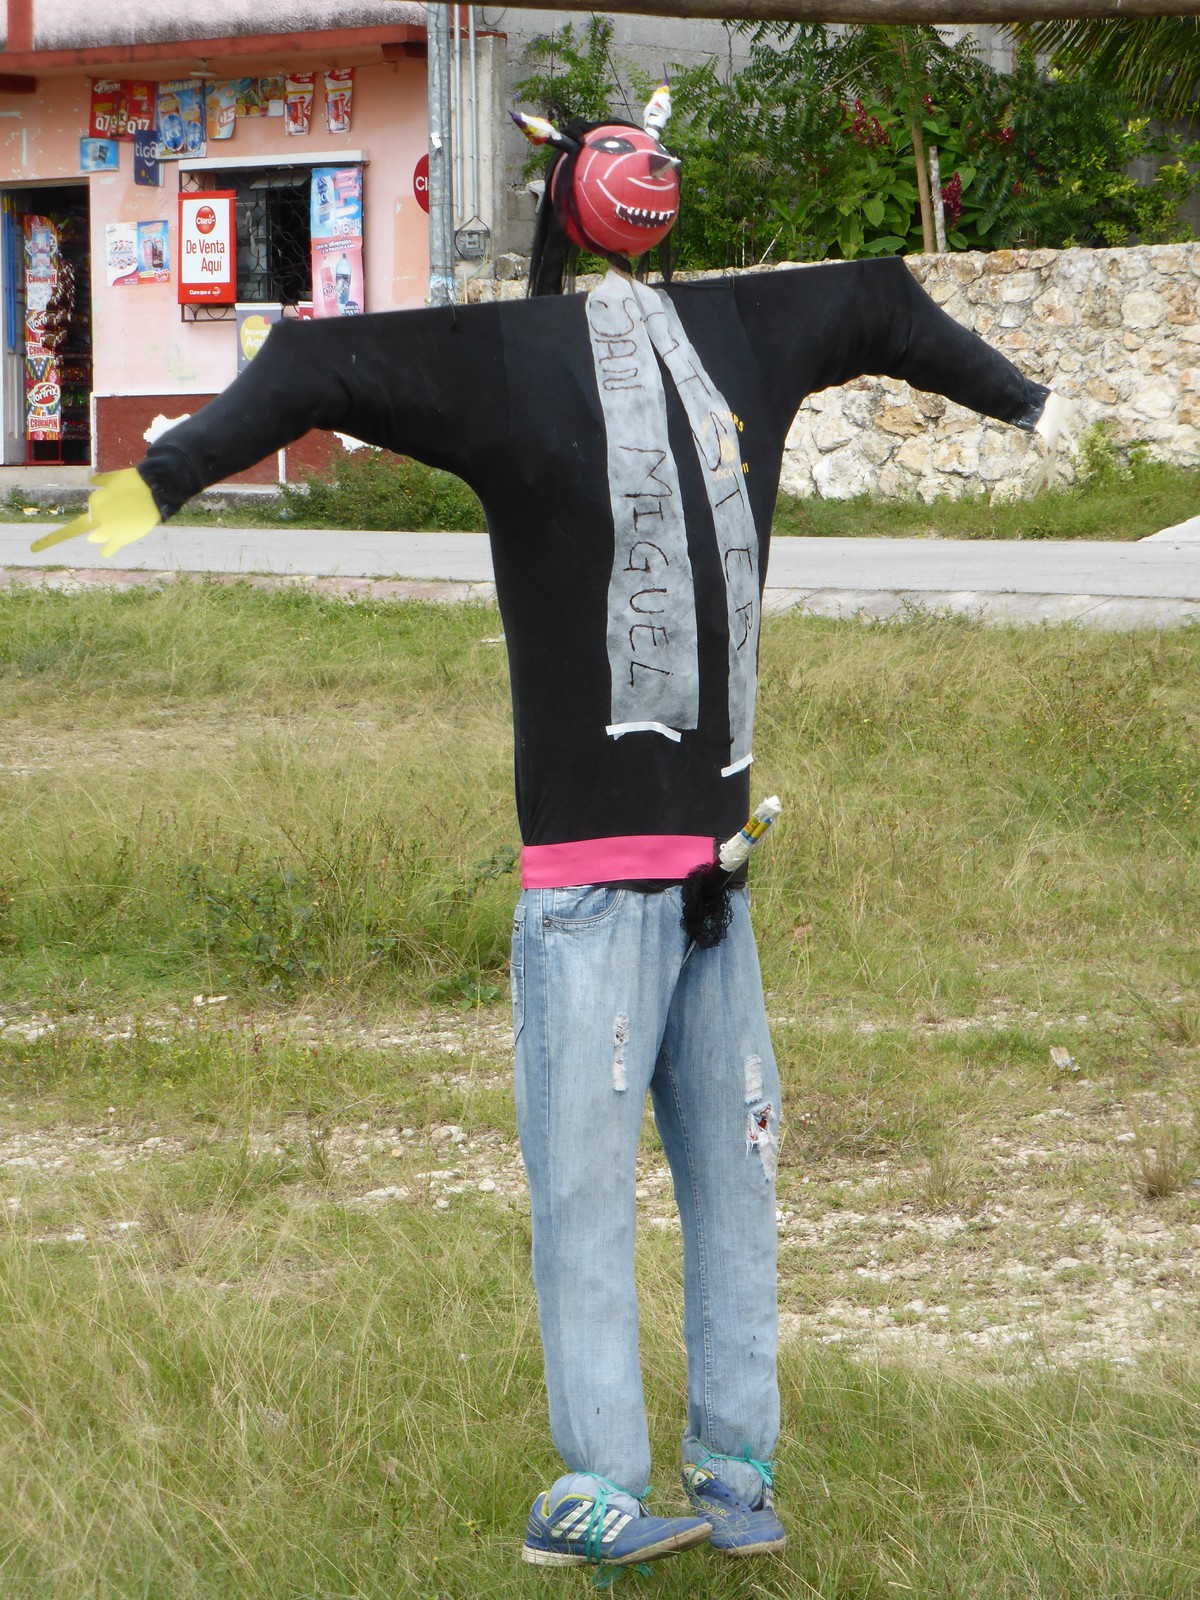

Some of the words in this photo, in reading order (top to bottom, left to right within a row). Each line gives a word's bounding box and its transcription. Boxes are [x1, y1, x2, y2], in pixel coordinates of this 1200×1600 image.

[135, 141, 157, 159] tigo
[196, 216, 213, 225] Claro
[186, 240, 197, 254] De
[199, 239, 225, 254] Venta
[201, 257, 223, 275] Aquí
[589, 297, 643, 391] SAN
[618, 445, 673, 689] MIGUEL
